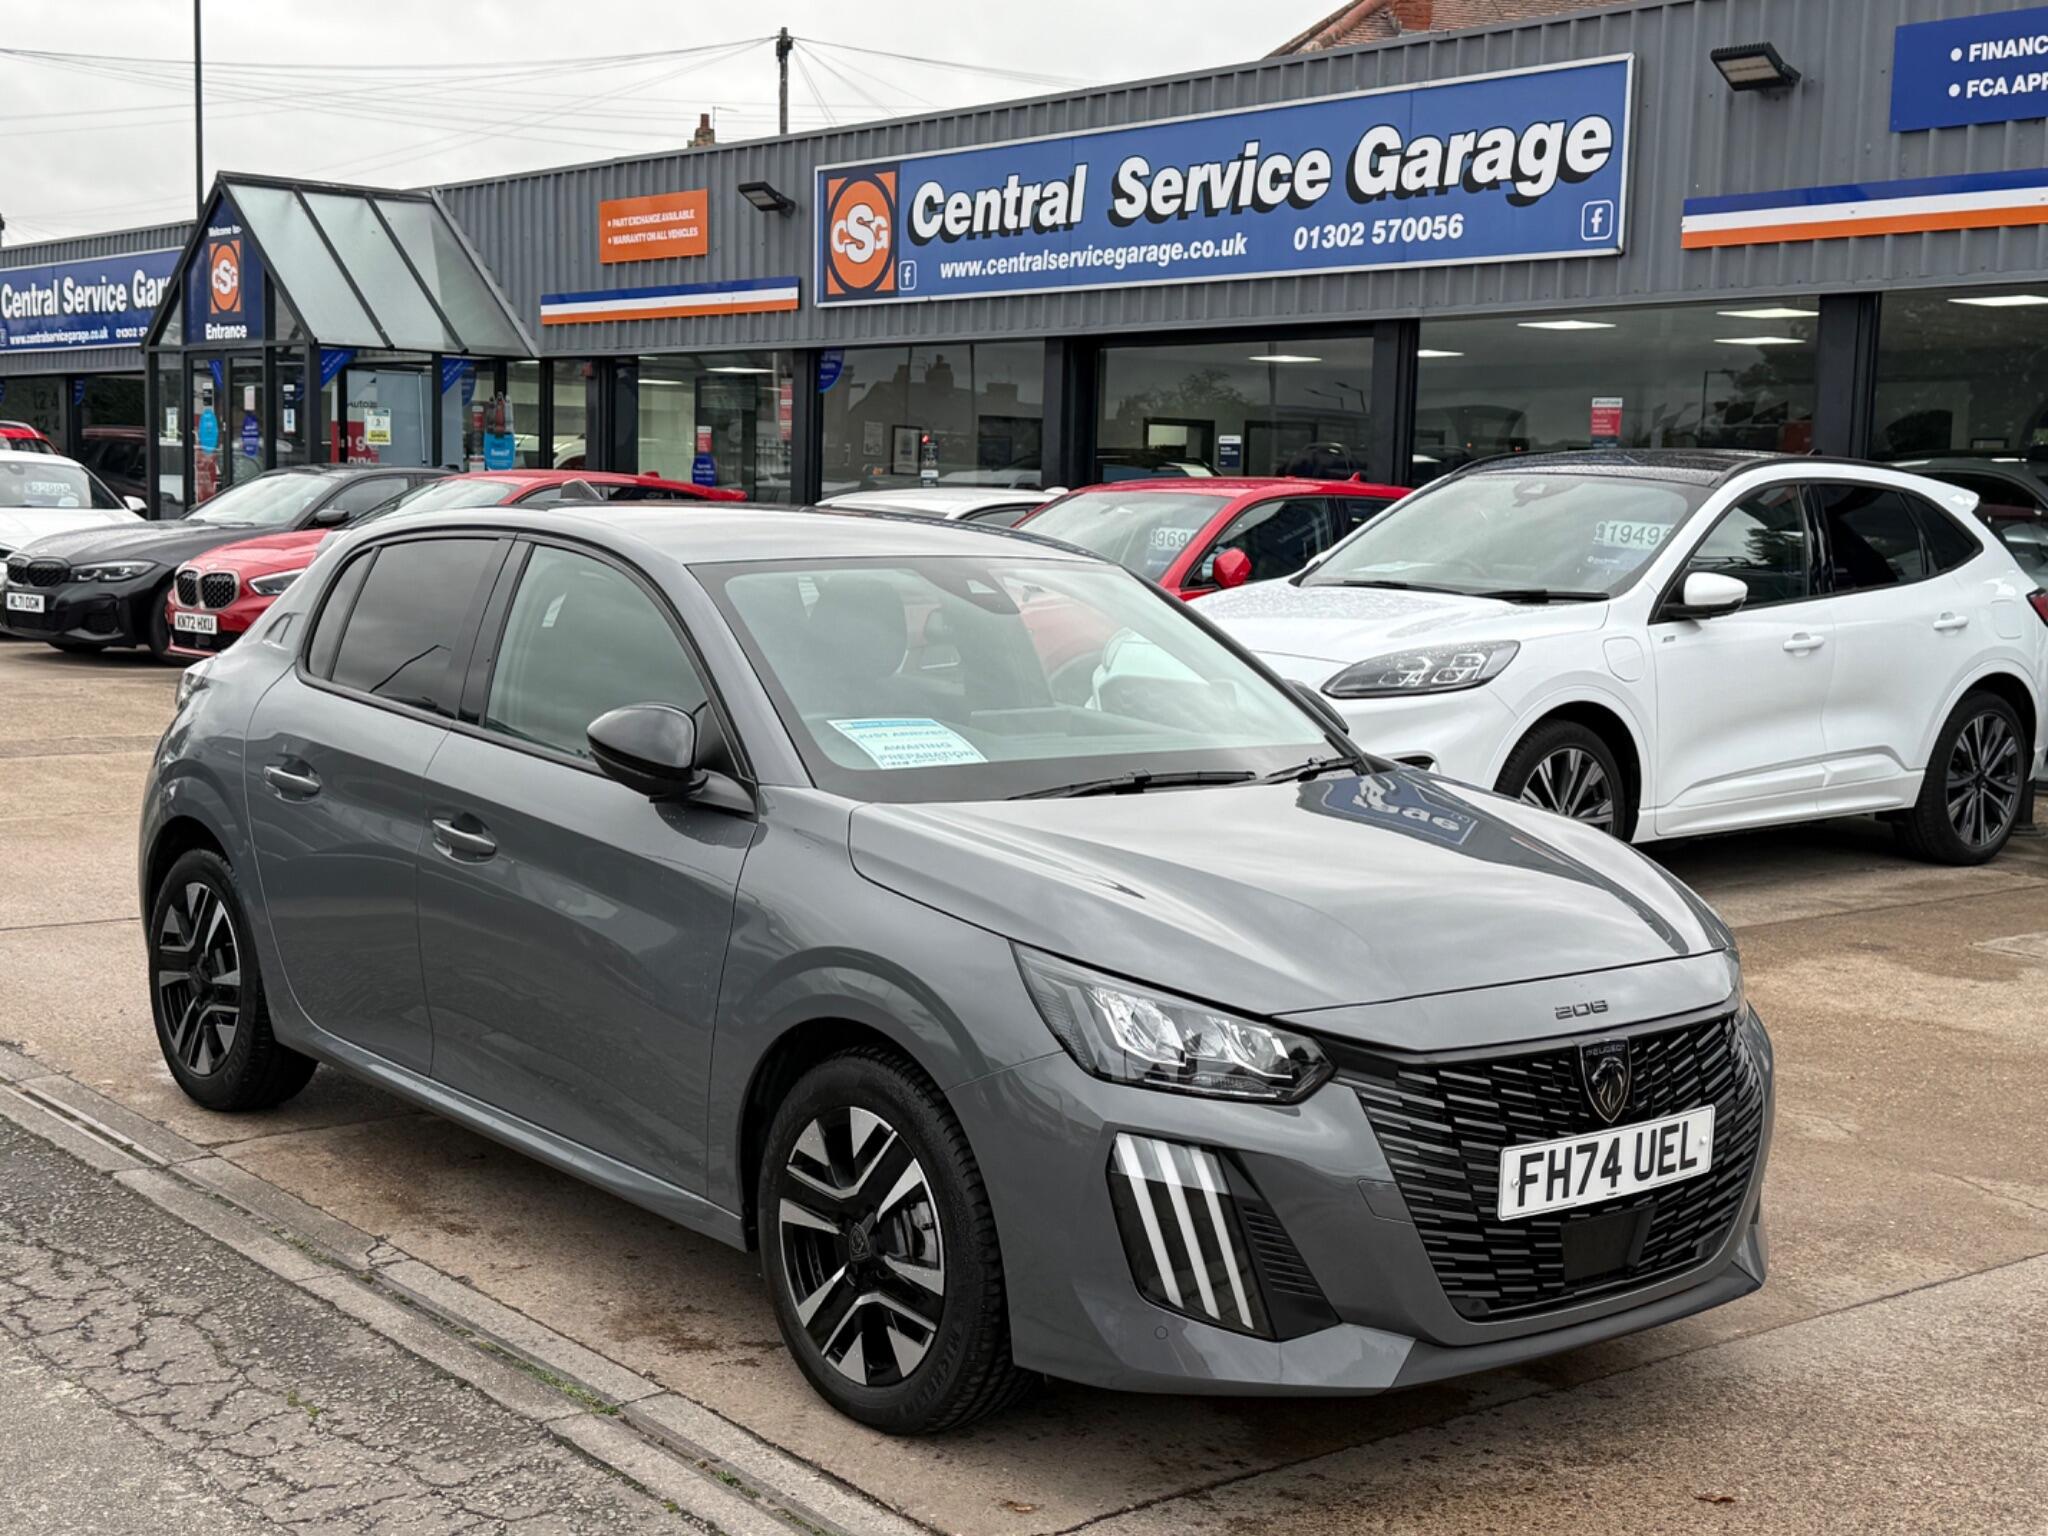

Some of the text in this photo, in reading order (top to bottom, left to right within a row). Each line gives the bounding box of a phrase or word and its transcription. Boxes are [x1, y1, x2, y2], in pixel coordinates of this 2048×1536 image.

[1968, 35, 2048, 62] FINANC
[1966, 76, 2008, 98] FCA
[911, 114, 1613, 239] Central Service Garage
[612, 208, 696, 228] PART EXCHANGE AVAILABLE
[208, 226, 231, 237] Welcome
[612, 226, 699, 245] WARRANTY ON ALL VEHICLES
[831, 203, 888, 264] CSG
[940, 213, 1464, 279] www.centralservicegarage.co.uk 01302 570056
[1, 278, 58, 319] Central
[63, 275, 127, 314] Service
[116, 326, 137, 339] 01302
[205, 323, 247, 340] Entrance
[879, 750, 975, 761] PREPARATION
[884, 741, 953, 751] AWAITING
[1555, 1000, 1608, 1020] 208
[1586, 1044, 1625, 1057] PEUGEOT
[1517, 1121, 1698, 1208] FH74 UEL
